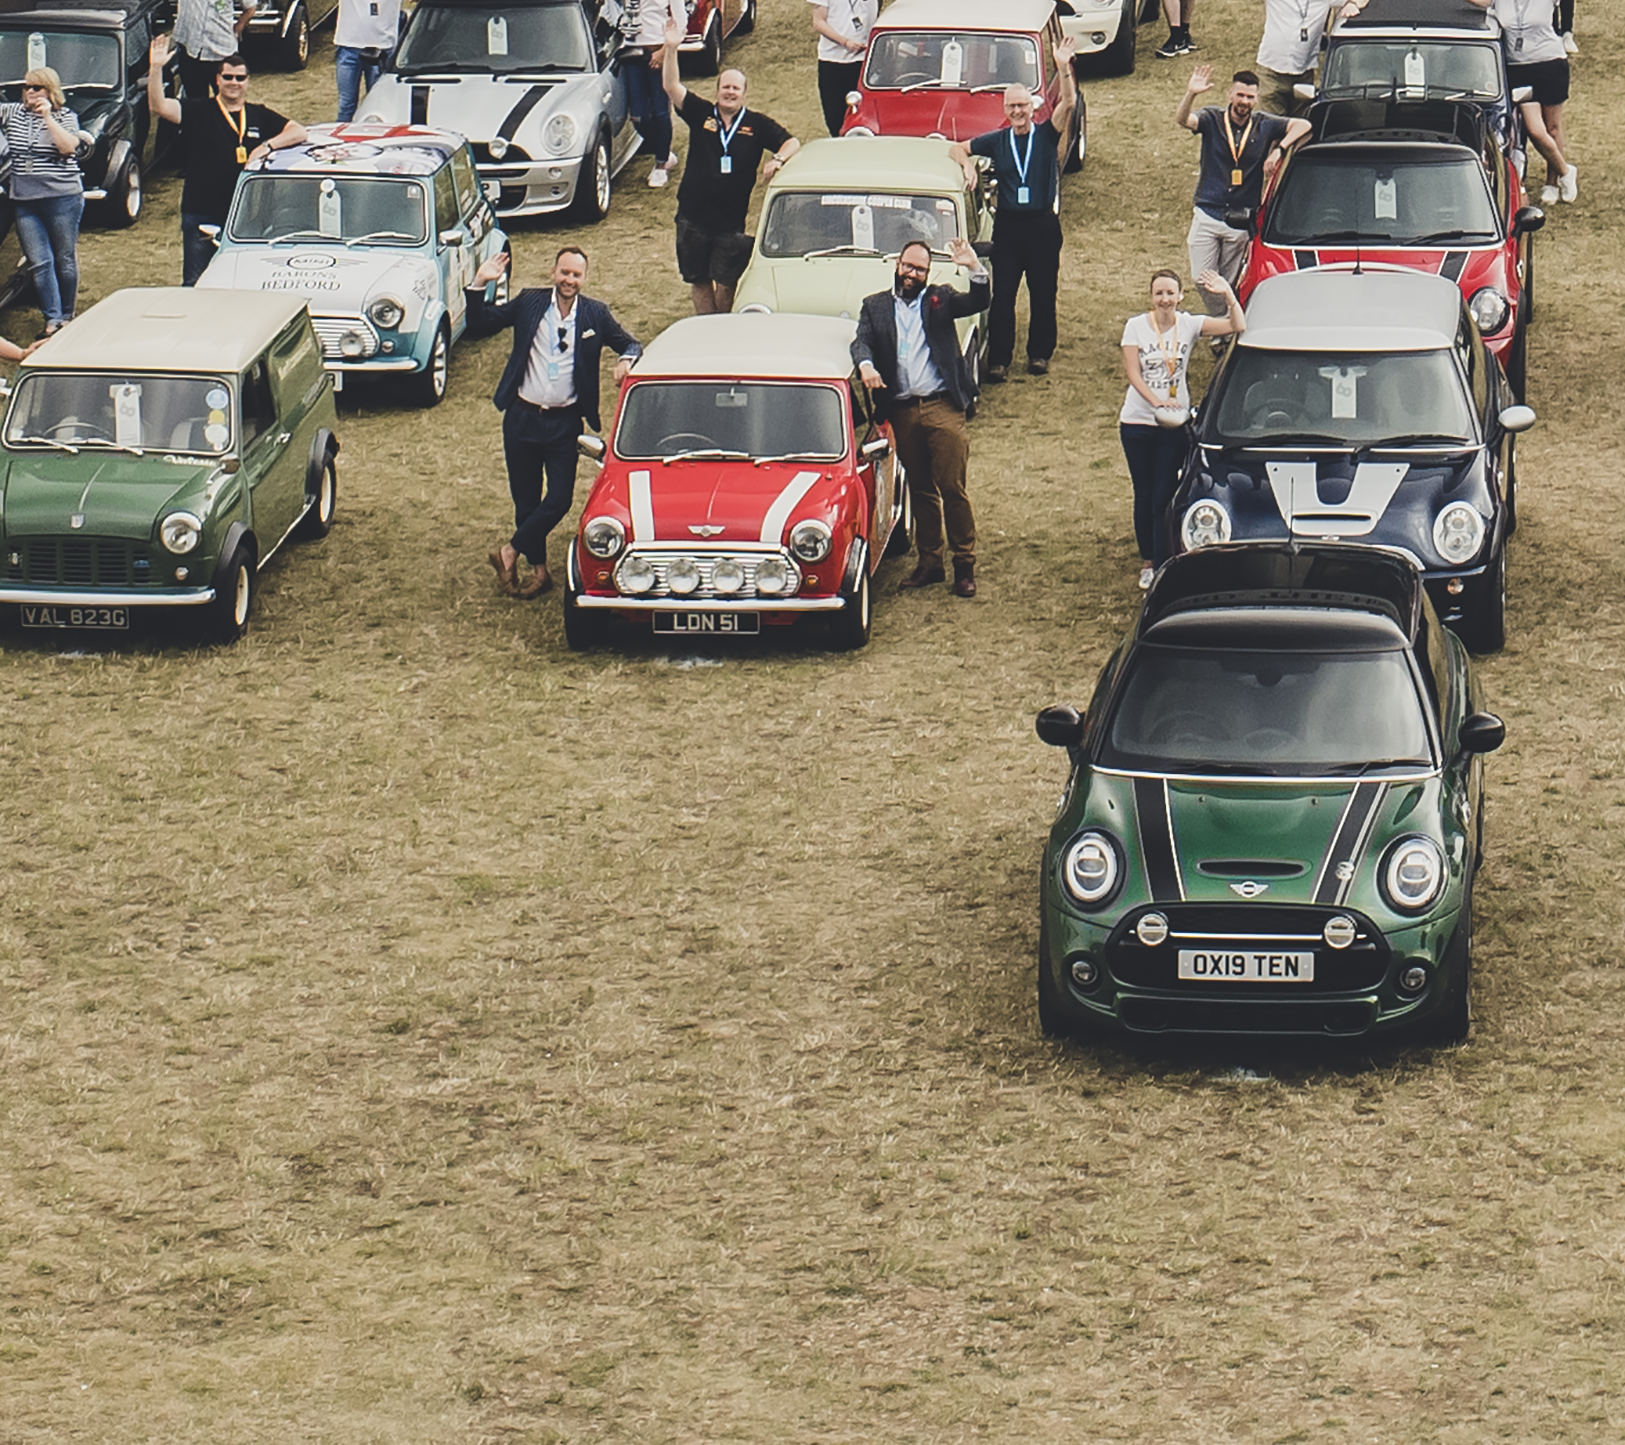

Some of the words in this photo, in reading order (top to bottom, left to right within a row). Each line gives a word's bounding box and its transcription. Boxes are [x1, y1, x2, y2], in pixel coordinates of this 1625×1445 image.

[262, 280, 340, 290] BEDFORD
[24, 607, 65, 625] VAL
[70, 609, 124, 625] 823G
[673, 613, 714, 630] LDN
[720, 613, 738, 630] 51
[1193, 954, 1245, 976] OX19
[1253, 954, 1299, 977] TEN
